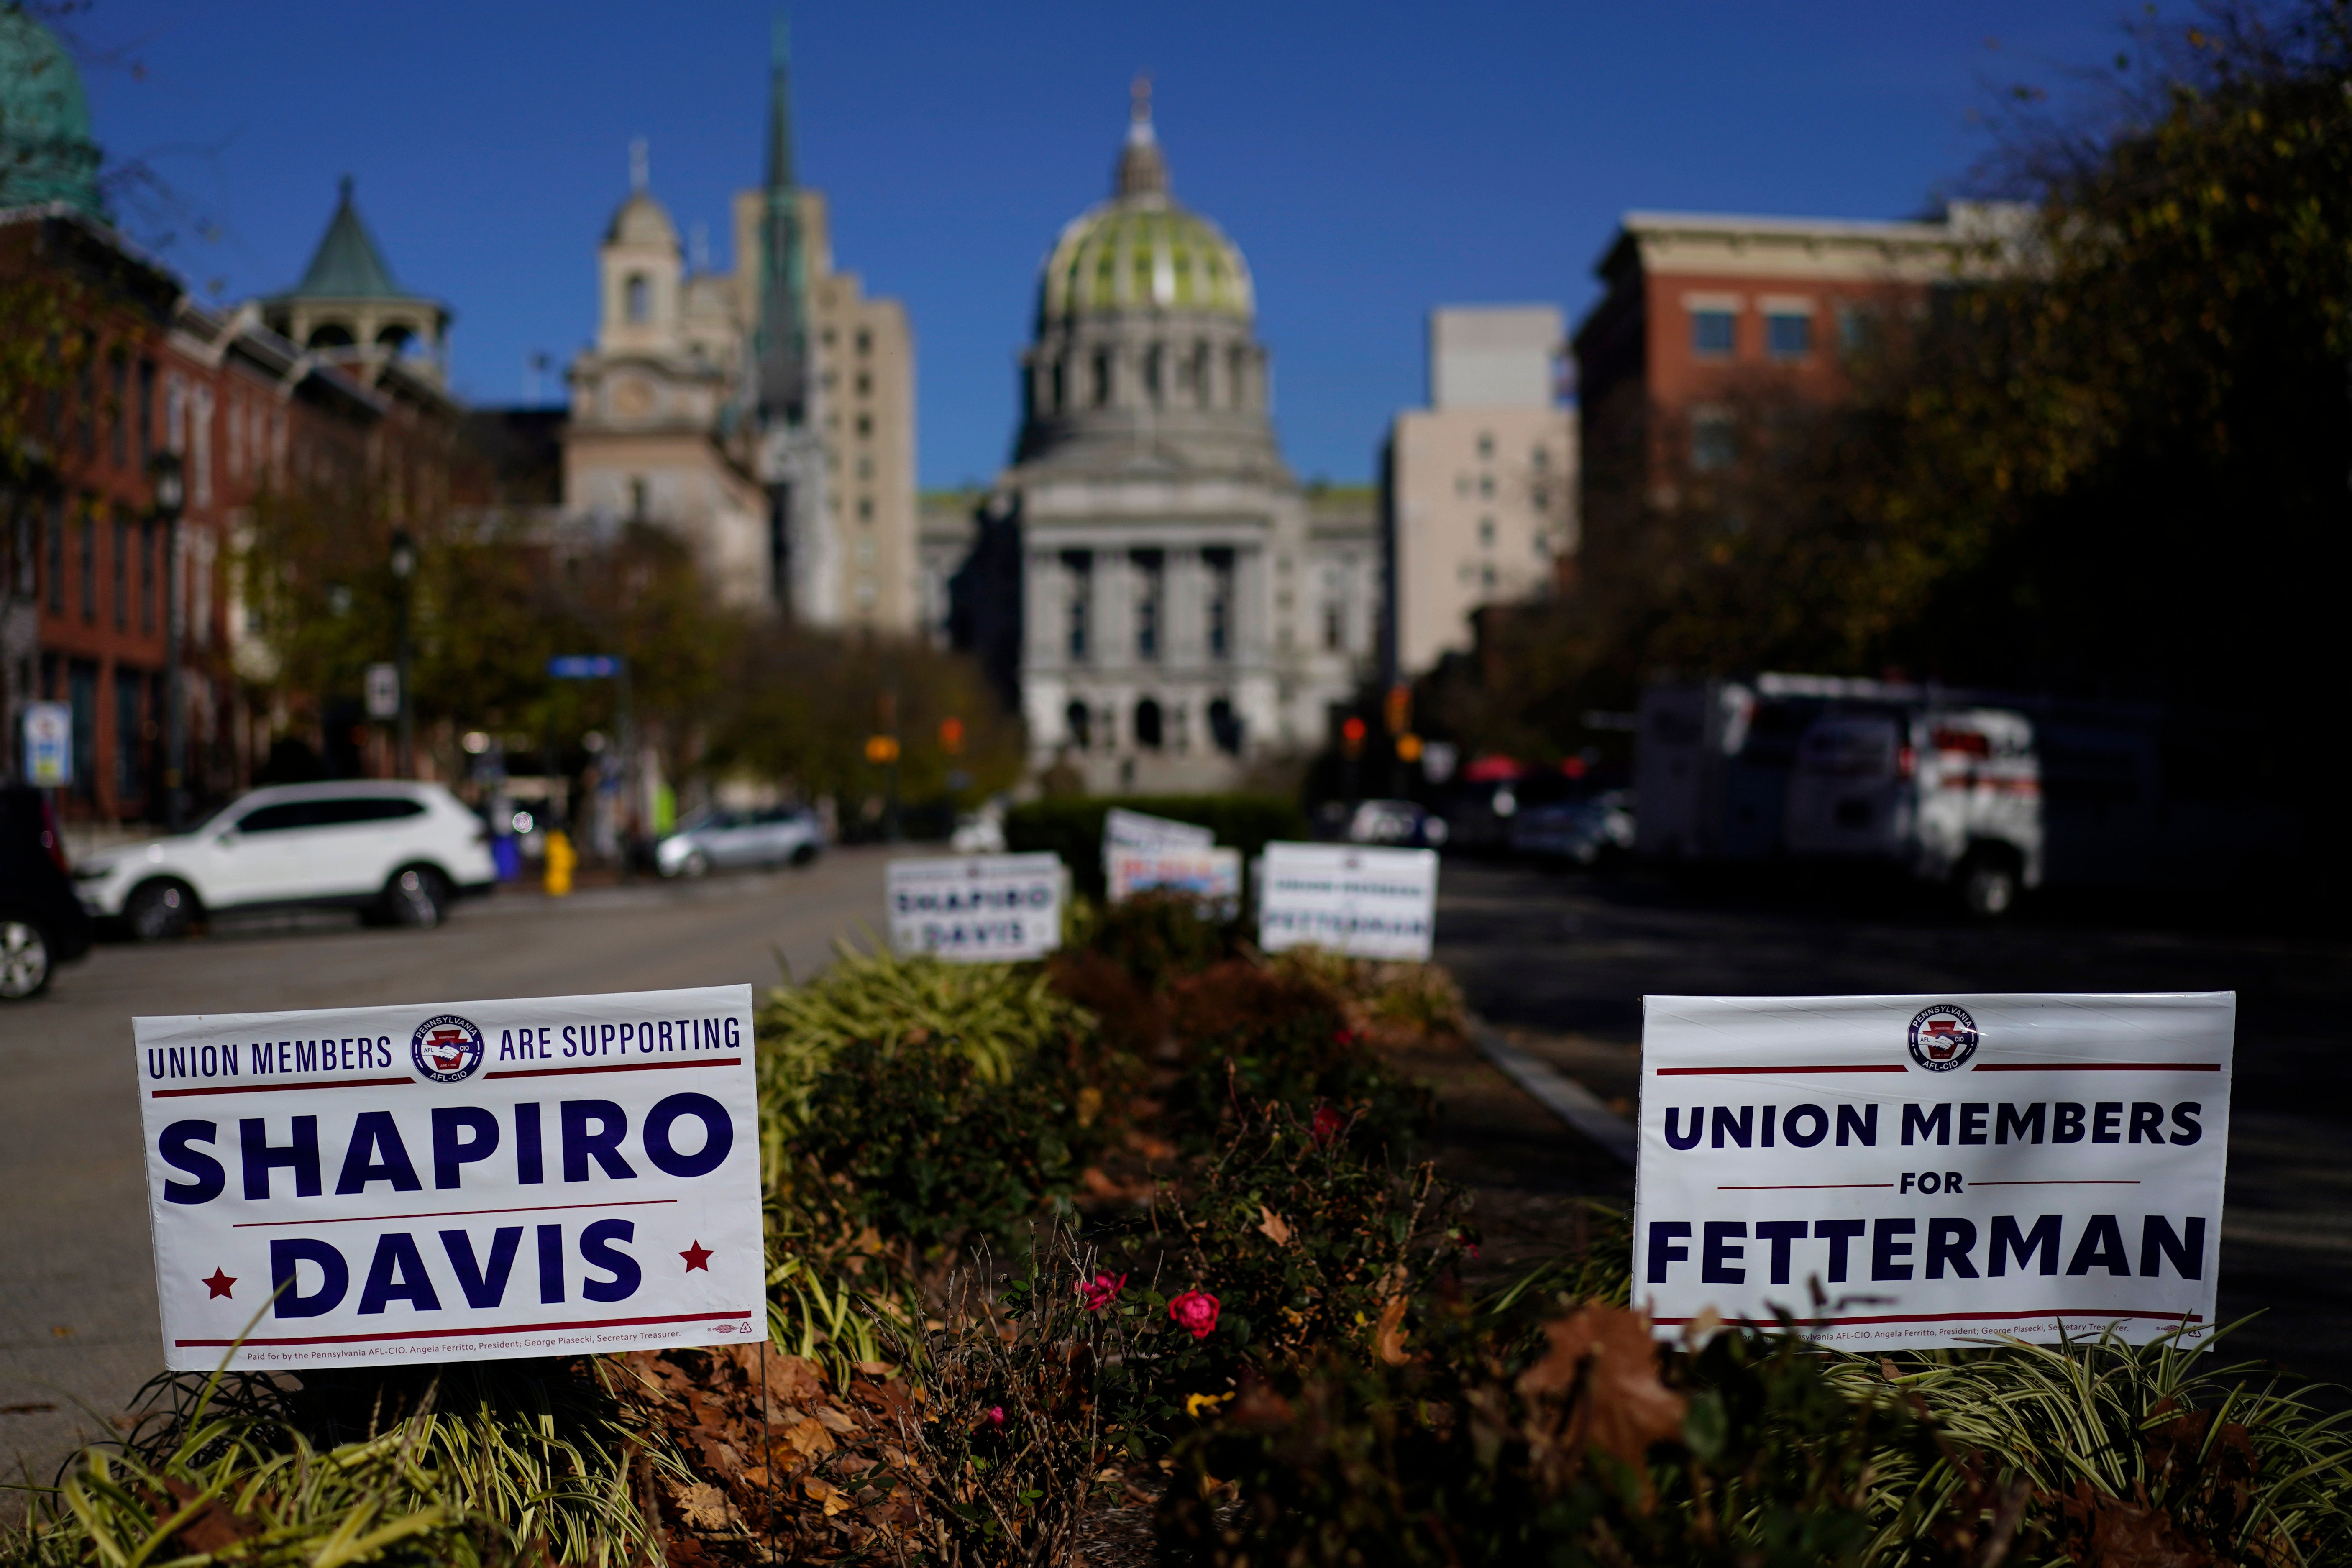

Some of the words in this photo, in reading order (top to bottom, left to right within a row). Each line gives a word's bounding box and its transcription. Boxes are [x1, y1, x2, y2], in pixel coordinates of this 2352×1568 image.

[923, 921, 1024, 945] DAVIS
[416, 1017, 477, 1039] PENNSYLVANIA
[1912, 1006, 1972, 1028] PENNSYLVANIA
[148, 1045, 238, 1079] UNION
[252, 1036, 392, 1075] MEMBERS
[500, 1028, 552, 1061] ARE
[563, 1017, 740, 1057] SUPPORTING
[430, 1071, 467, 1081] AFL-CIO
[1922, 1060, 1958, 1070] AFL-CIO
[1665, 1103, 1878, 1151] UNION
[1901, 1102, 2203, 1146] MEMBERS
[159, 1092, 734, 1205] SHAPIRO
[1900, 1172, 1963, 1195] FOR
[1648, 1214, 2206, 1284] FETTERMAN
[270, 1219, 642, 1319] DAVIS
[312, 1349, 365, 1358] Pennsylvania
[369, 1347, 407, 1356] AFL-CIO.
[410, 1345, 439, 1354] Angela
[558, 1336, 594, 1344] Piasecki,
[597, 1333, 637, 1342] Secretary
[1875, 1330, 1902, 1339] Angela
